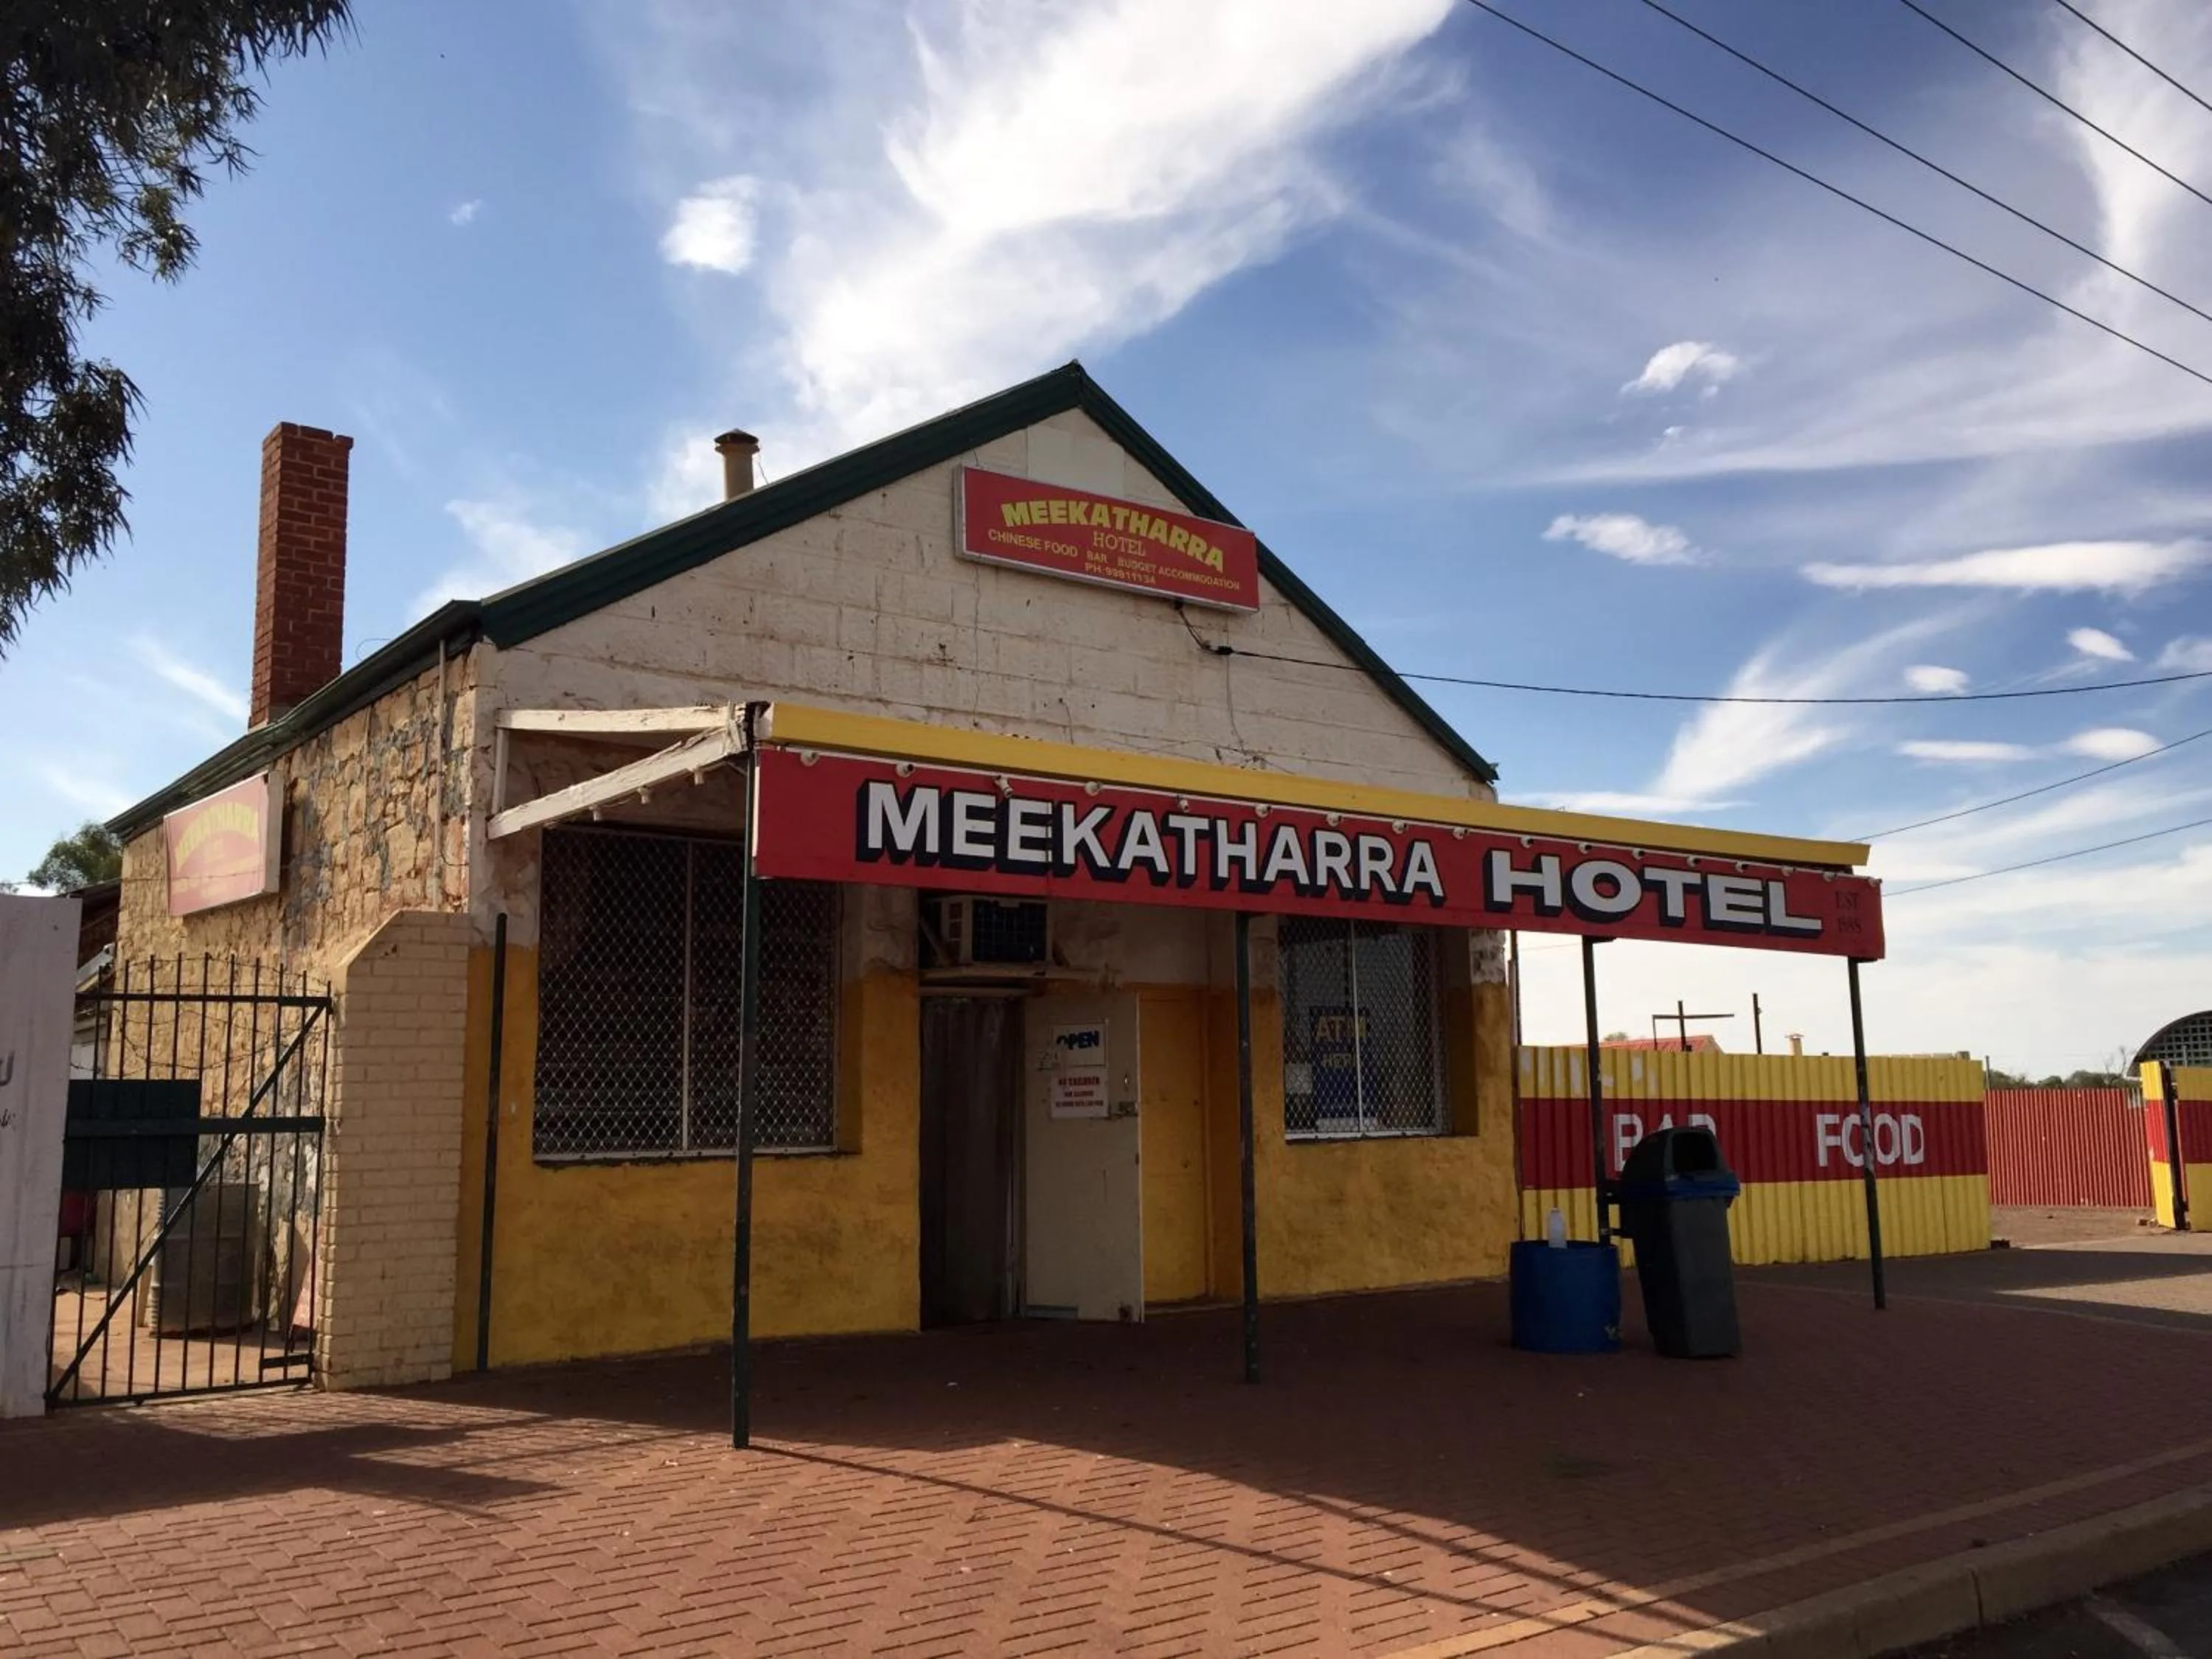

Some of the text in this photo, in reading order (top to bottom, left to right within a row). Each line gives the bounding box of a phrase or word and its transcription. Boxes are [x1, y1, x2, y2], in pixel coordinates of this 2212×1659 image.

[988, 529, 1079, 558] CHINESE FOOD
[1001, 499, 1224, 573] MEEKATHARRA
[1093, 530, 1146, 557] HOTEL
[1086, 550, 1108, 564] BAR
[1117, 556, 1157, 575] BUDGET
[863, 780, 1823, 933] MEEKATHARRA HOTEL
[1816, 1113, 1925, 1168] FOOD
